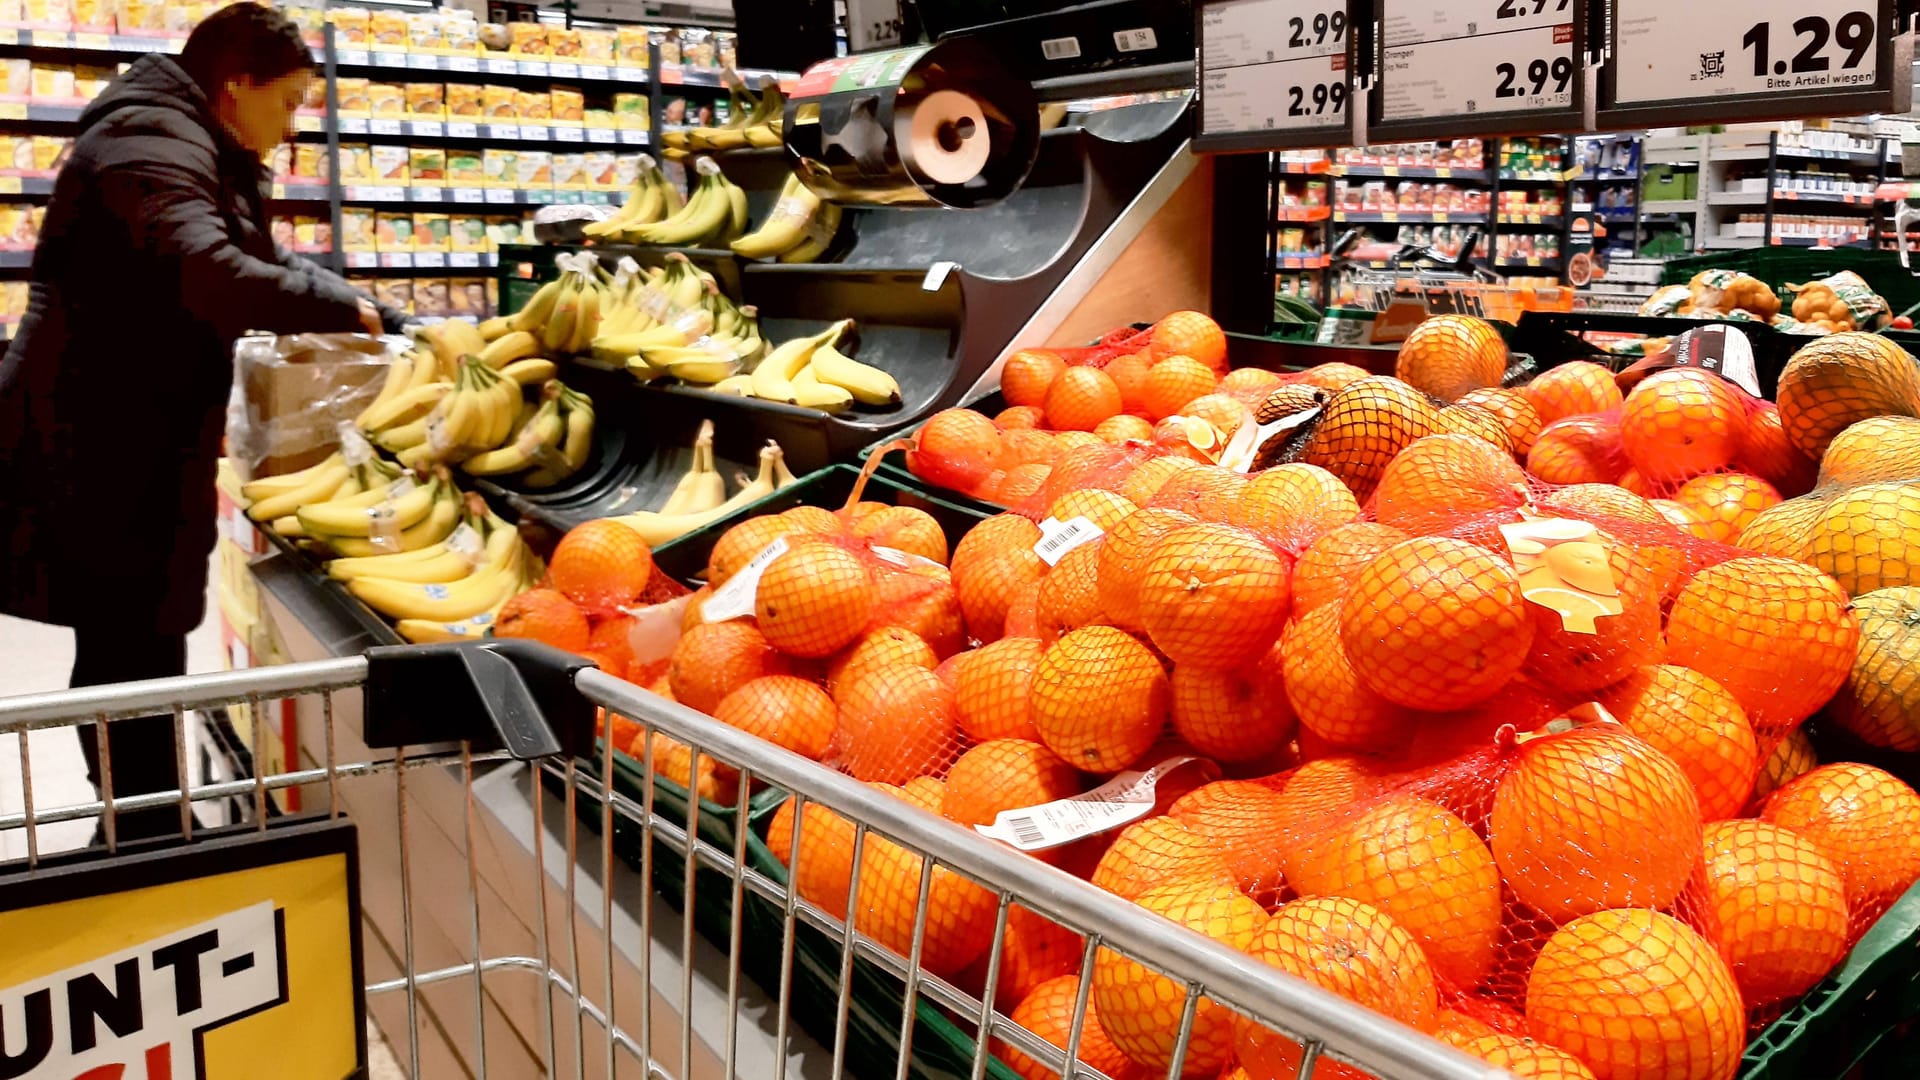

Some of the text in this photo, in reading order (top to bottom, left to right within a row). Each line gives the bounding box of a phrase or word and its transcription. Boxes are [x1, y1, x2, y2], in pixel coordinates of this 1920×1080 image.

[1289, 10, 1346, 48] 2.99
[1743, 11, 1875, 77] 1.29
[1496, 57, 1572, 98] 2.99
[1767, 71, 1875, 89] Bitte Artikel wiegen!
[1288, 82, 1346, 117] 2.99
